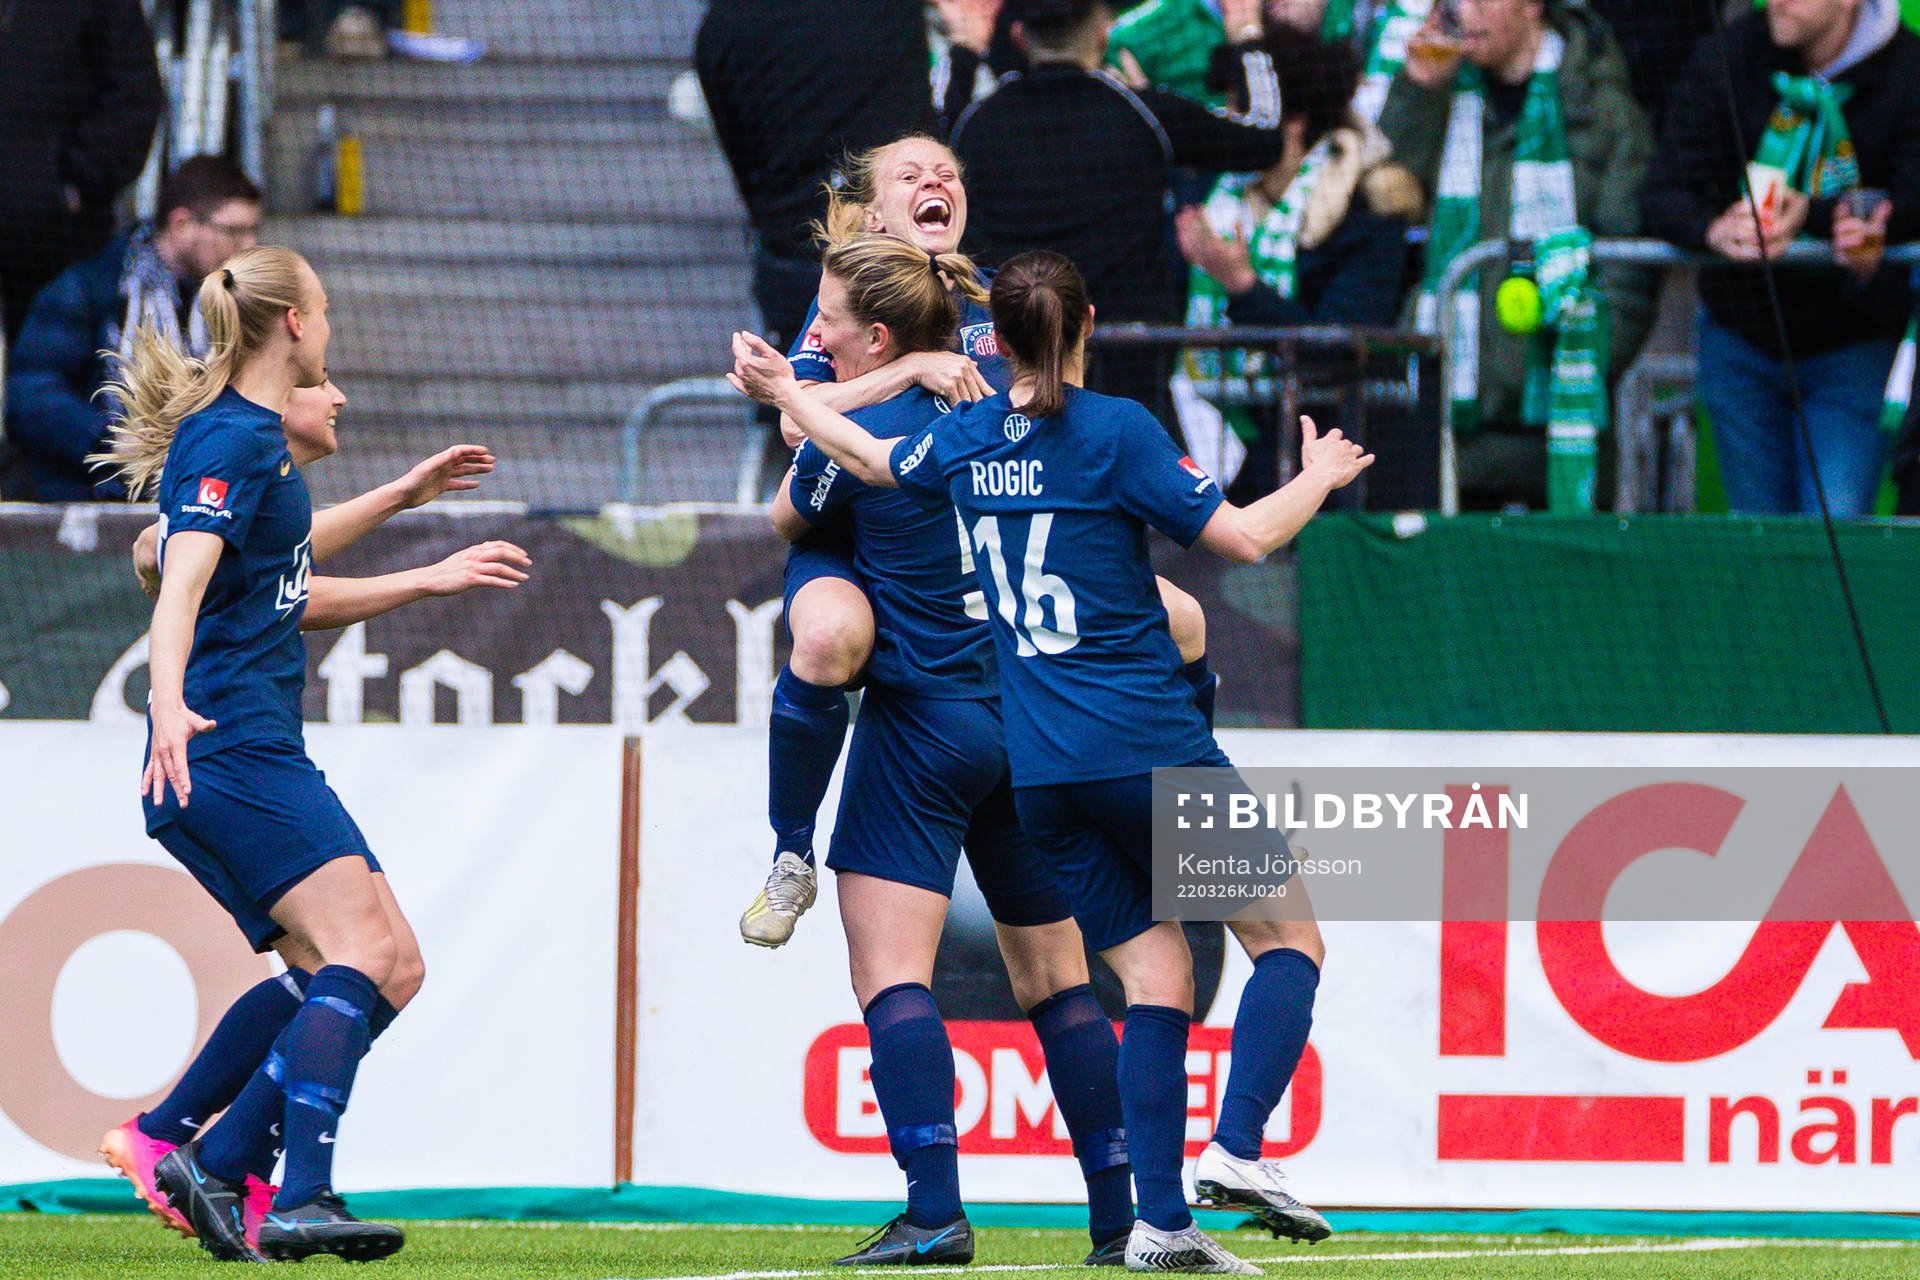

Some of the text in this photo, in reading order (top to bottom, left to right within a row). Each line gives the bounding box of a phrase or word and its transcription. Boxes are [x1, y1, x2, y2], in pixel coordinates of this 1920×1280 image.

[970, 460, 1043, 496] ROGIC
[972, 512, 1081, 657] 16
[1438, 780, 1920, 1064] ICA
